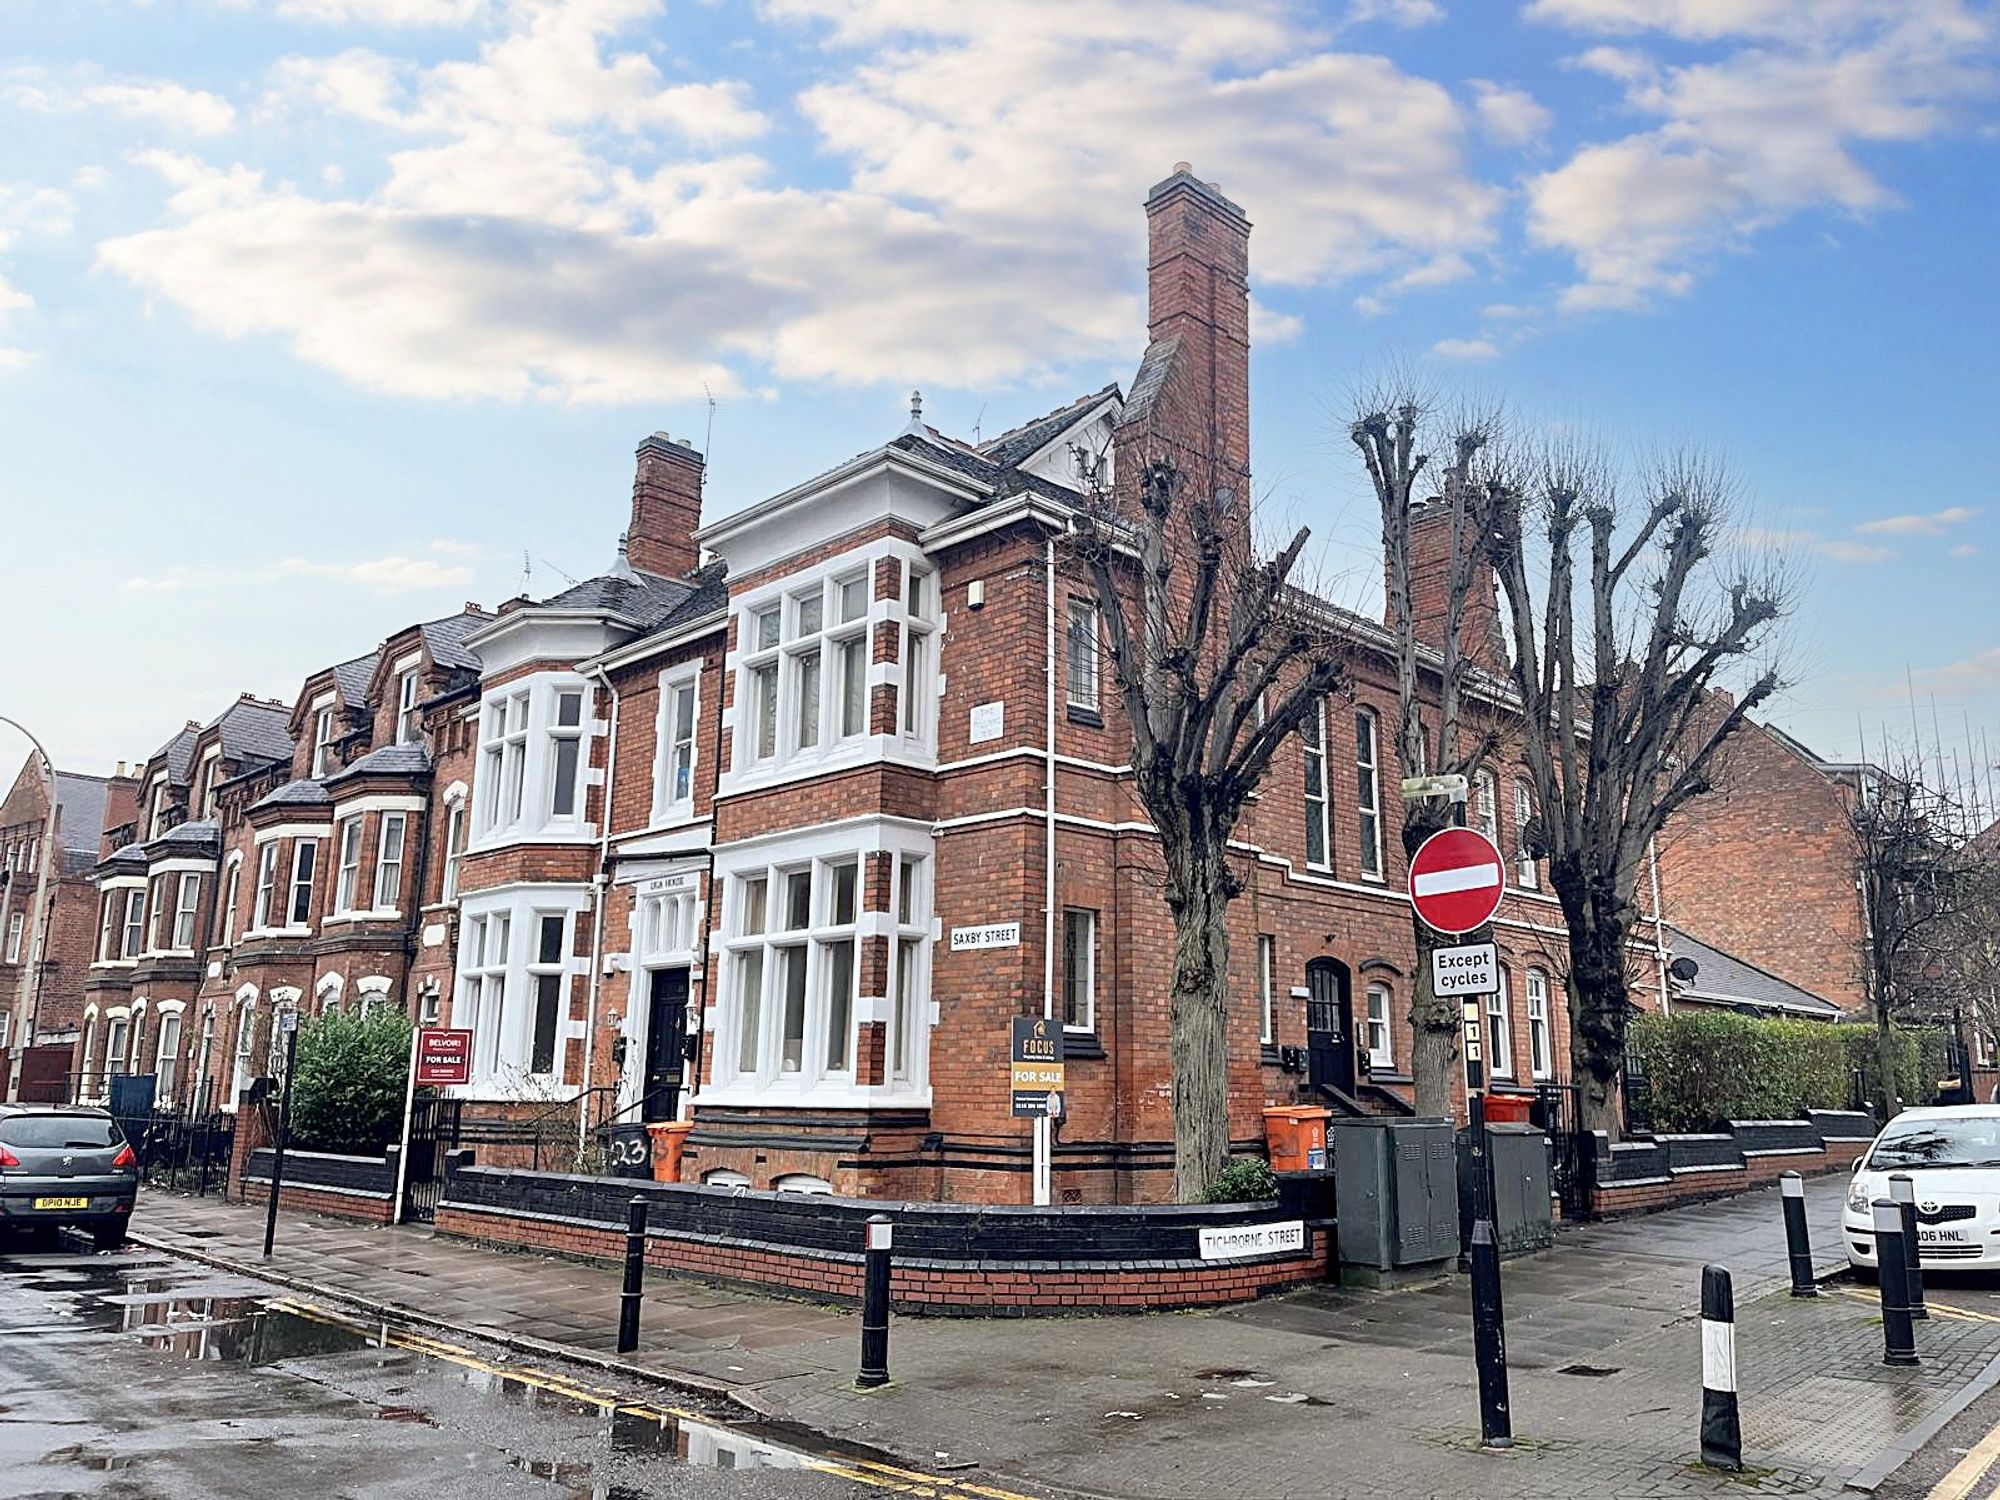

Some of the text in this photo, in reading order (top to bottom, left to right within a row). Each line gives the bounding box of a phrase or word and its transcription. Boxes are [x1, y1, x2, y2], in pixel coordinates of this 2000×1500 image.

[953, 928, 1016, 945] SAXBY STREET
[1438, 951, 1489, 969] Except
[1441, 971, 1487, 989] cycles
[1023, 1040, 1054, 1054] FOCUS
[426, 1056, 461, 1064] FOR SALE
[1015, 1071, 1062, 1083] FOR SALE
[1204, 1228, 1301, 1251] TICHBORNE STREET
[1939, 1230, 1964, 1242] HNL
